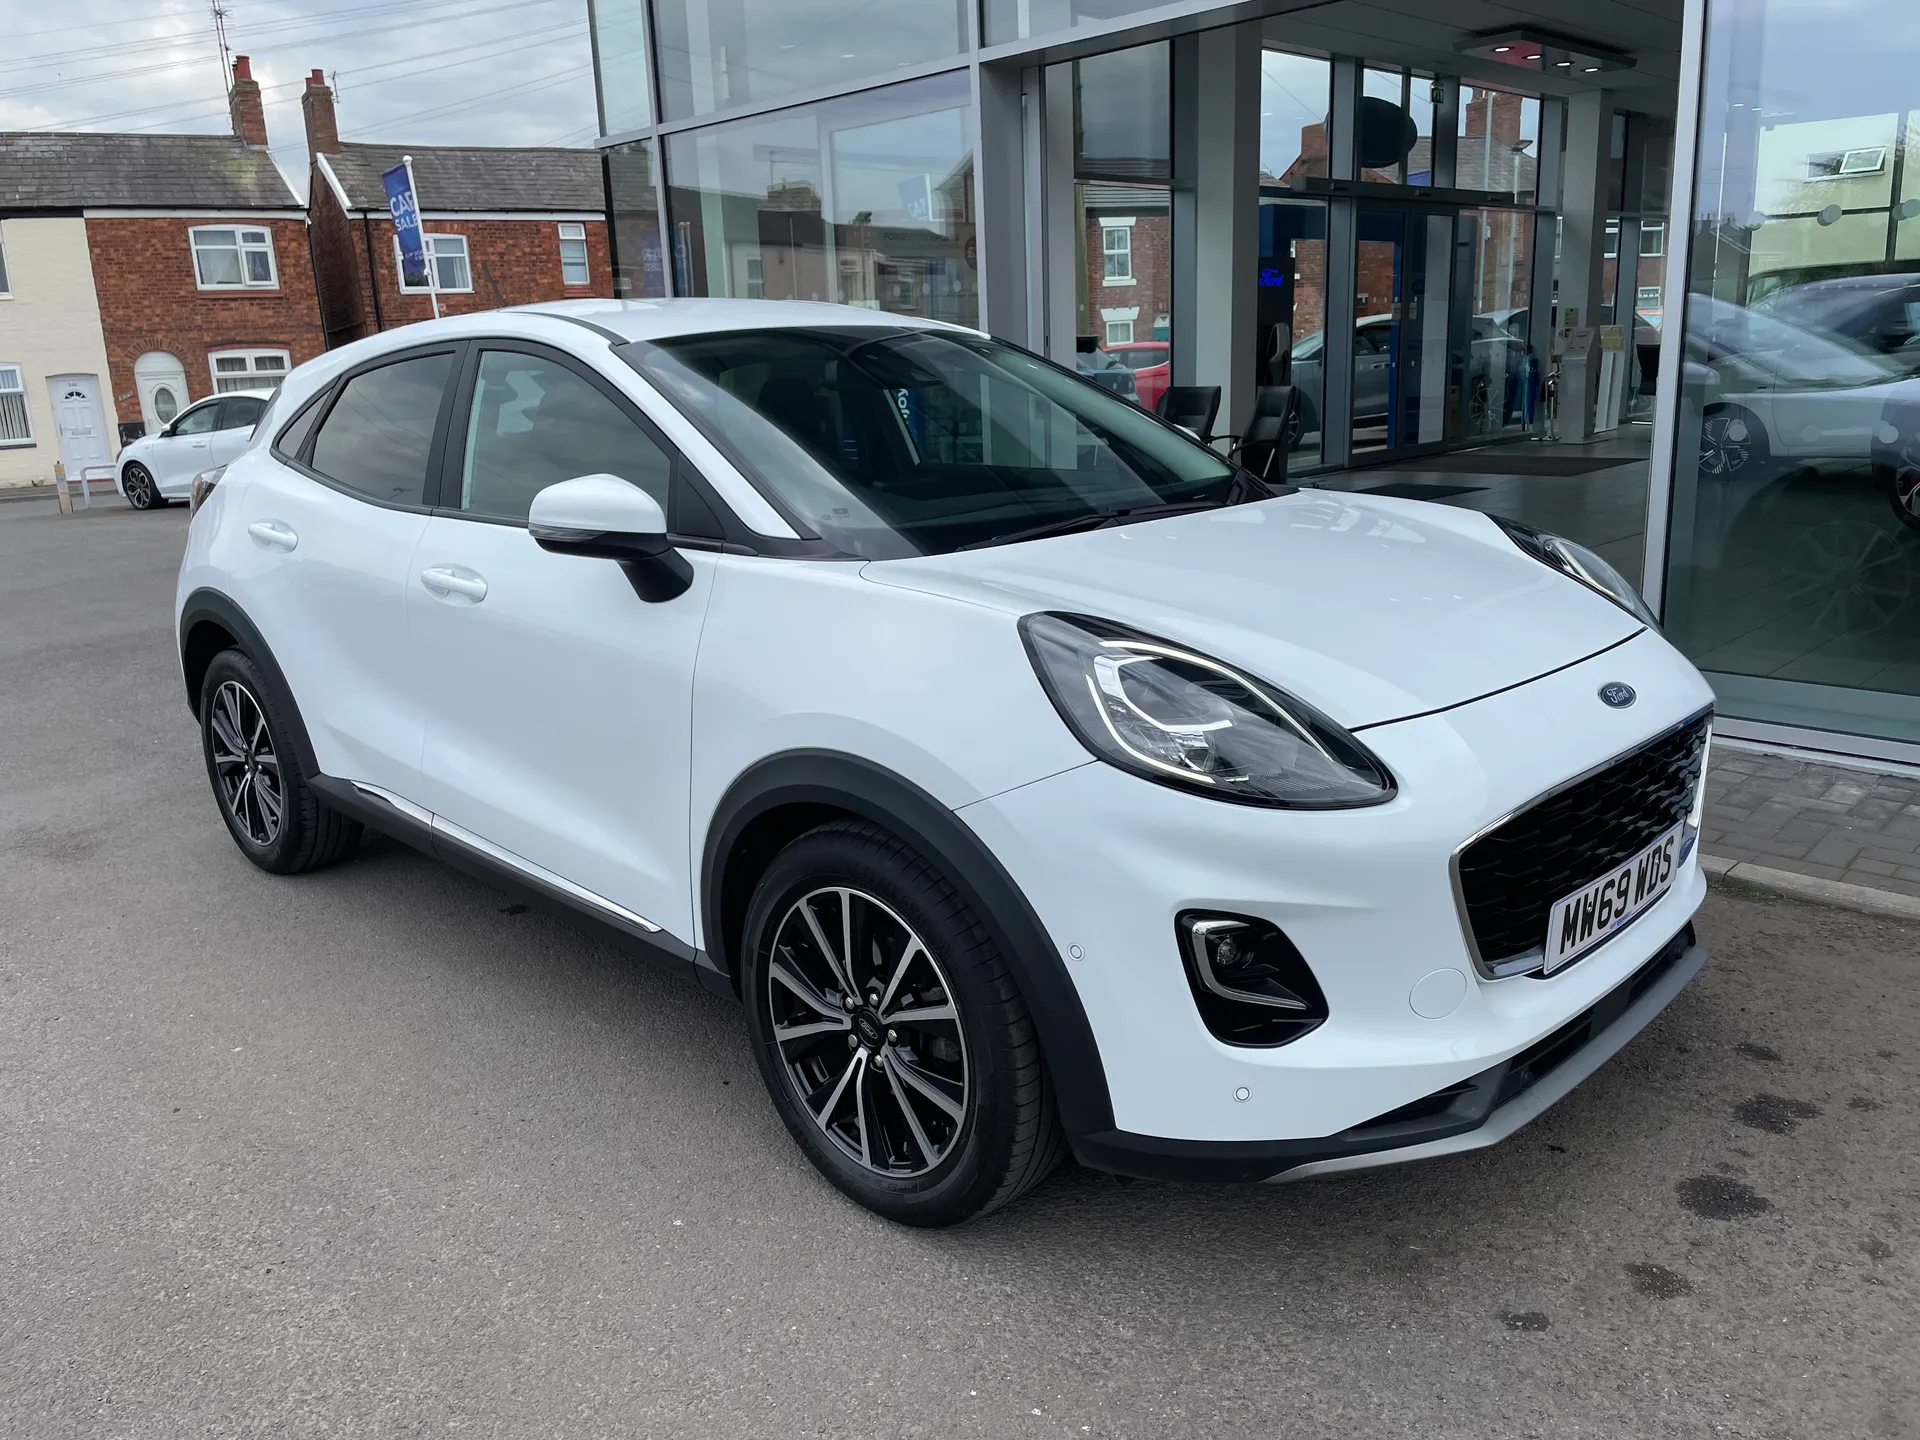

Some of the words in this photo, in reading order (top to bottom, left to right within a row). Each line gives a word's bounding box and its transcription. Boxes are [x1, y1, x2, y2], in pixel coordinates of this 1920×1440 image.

[1259, 268, 1284, 287] Ford
[1606, 687, 1630, 704] Ford
[1560, 868, 1631, 955] MW69
[1634, 835, 1674, 905] WDS
